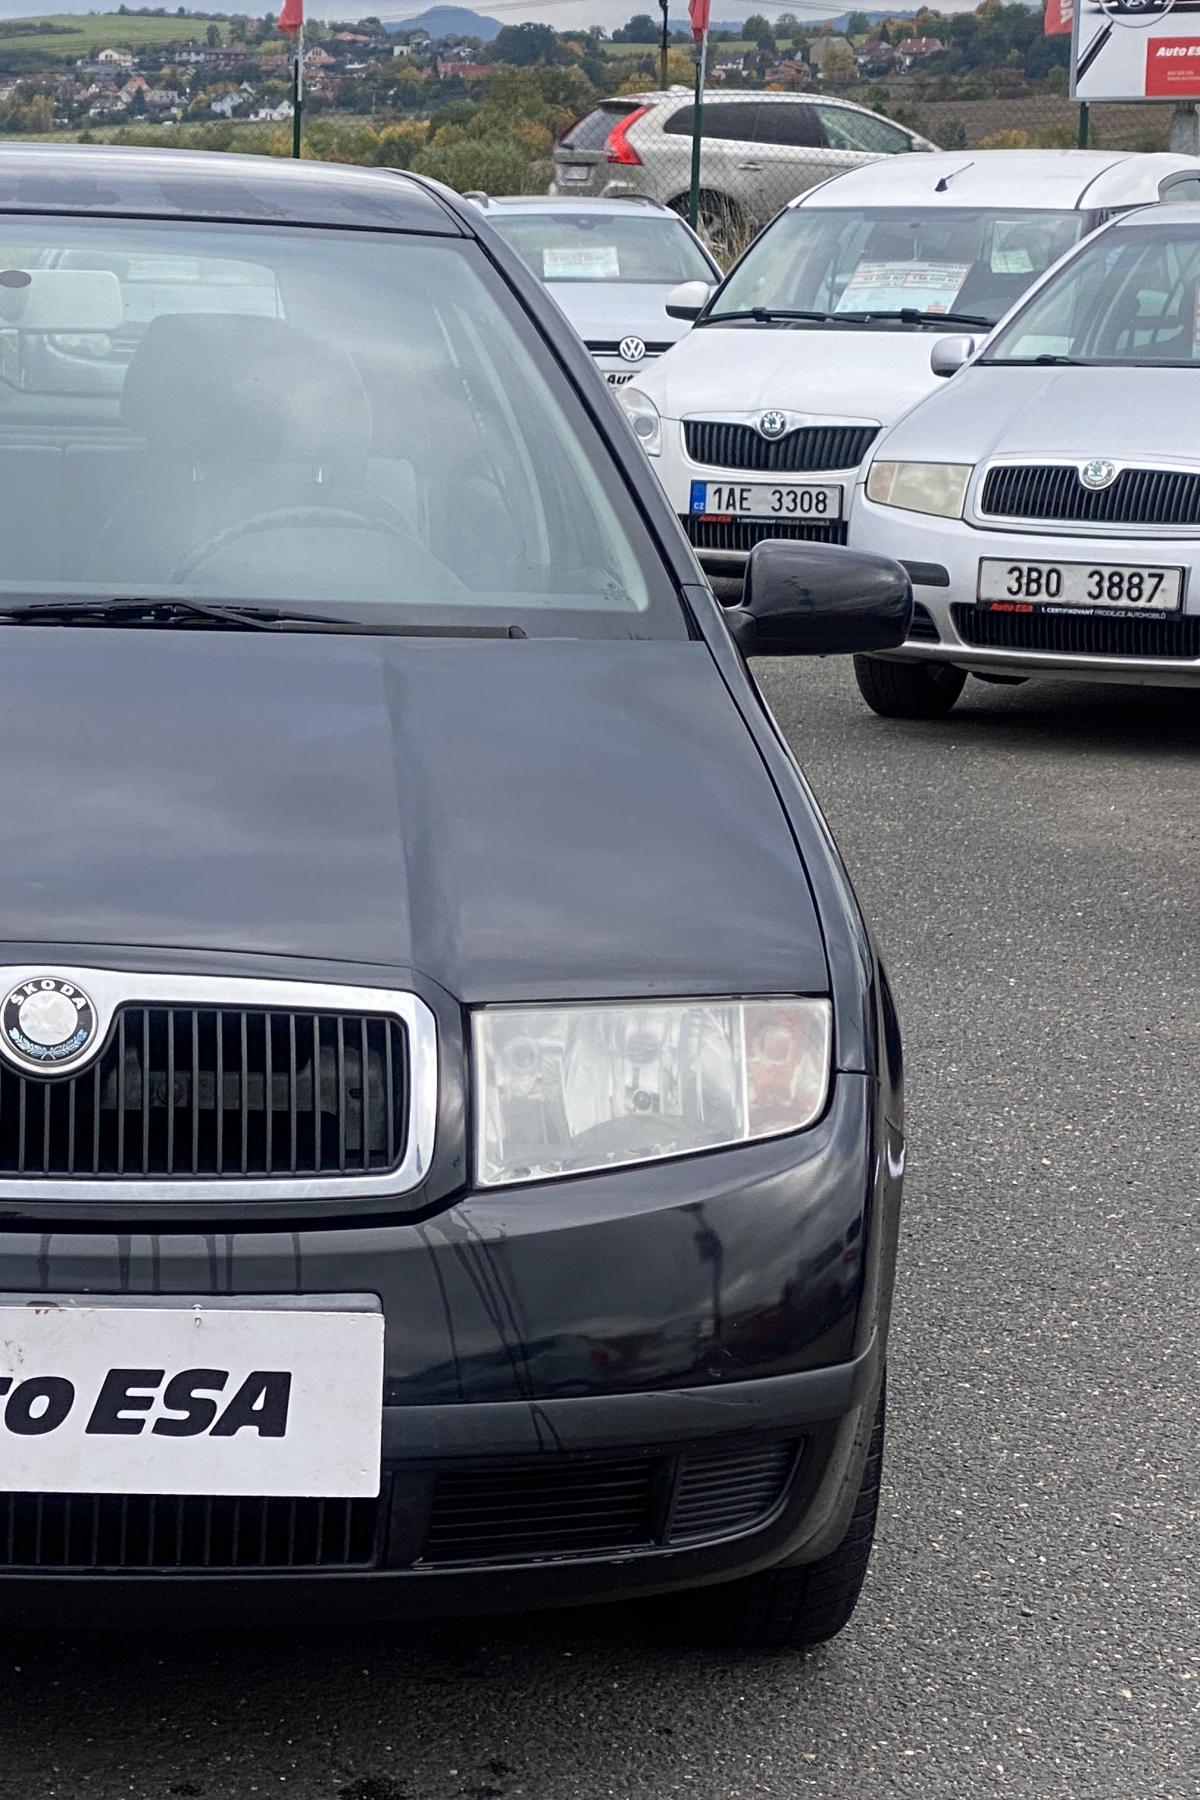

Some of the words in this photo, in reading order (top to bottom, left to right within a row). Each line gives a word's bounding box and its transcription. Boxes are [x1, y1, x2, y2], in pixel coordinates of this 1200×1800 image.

[1156, 46, 1187, 57] Auto
[693, 502, 705, 510] CZ
[713, 487, 752, 512] 1AE
[771, 489, 828, 513] 3308
[1006, 566, 1062, 598] 3B0
[1087, 570, 1165, 604] 3887
[85, 1368, 293, 1438] ESA
